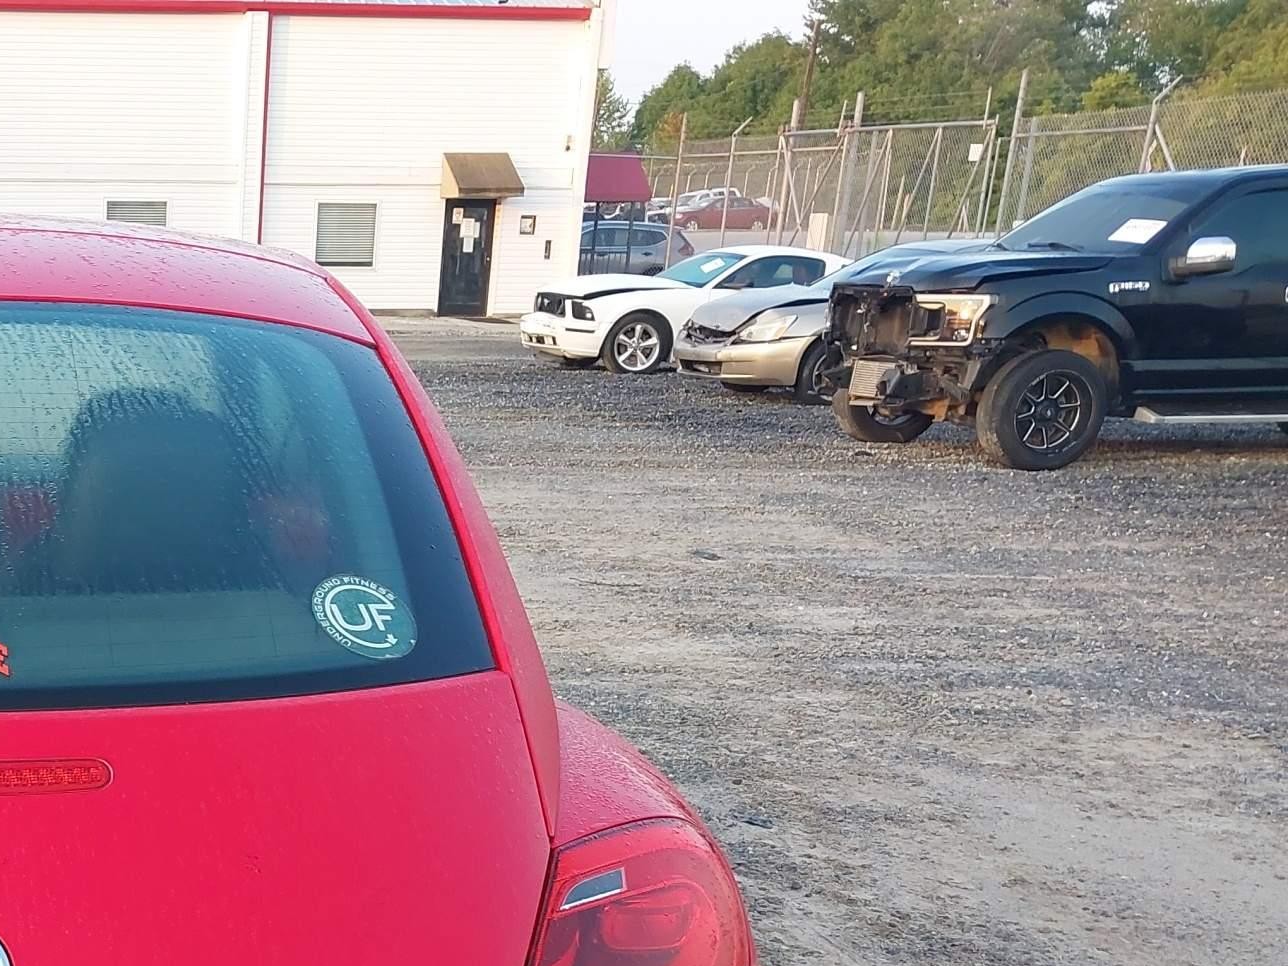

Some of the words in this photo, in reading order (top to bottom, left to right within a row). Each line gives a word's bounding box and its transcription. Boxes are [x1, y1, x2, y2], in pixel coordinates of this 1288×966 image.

[313, 577, 352, 648] UNDERGROUND
[343, 576, 397, 601] FITNESS
[329, 603, 396, 631] UF
